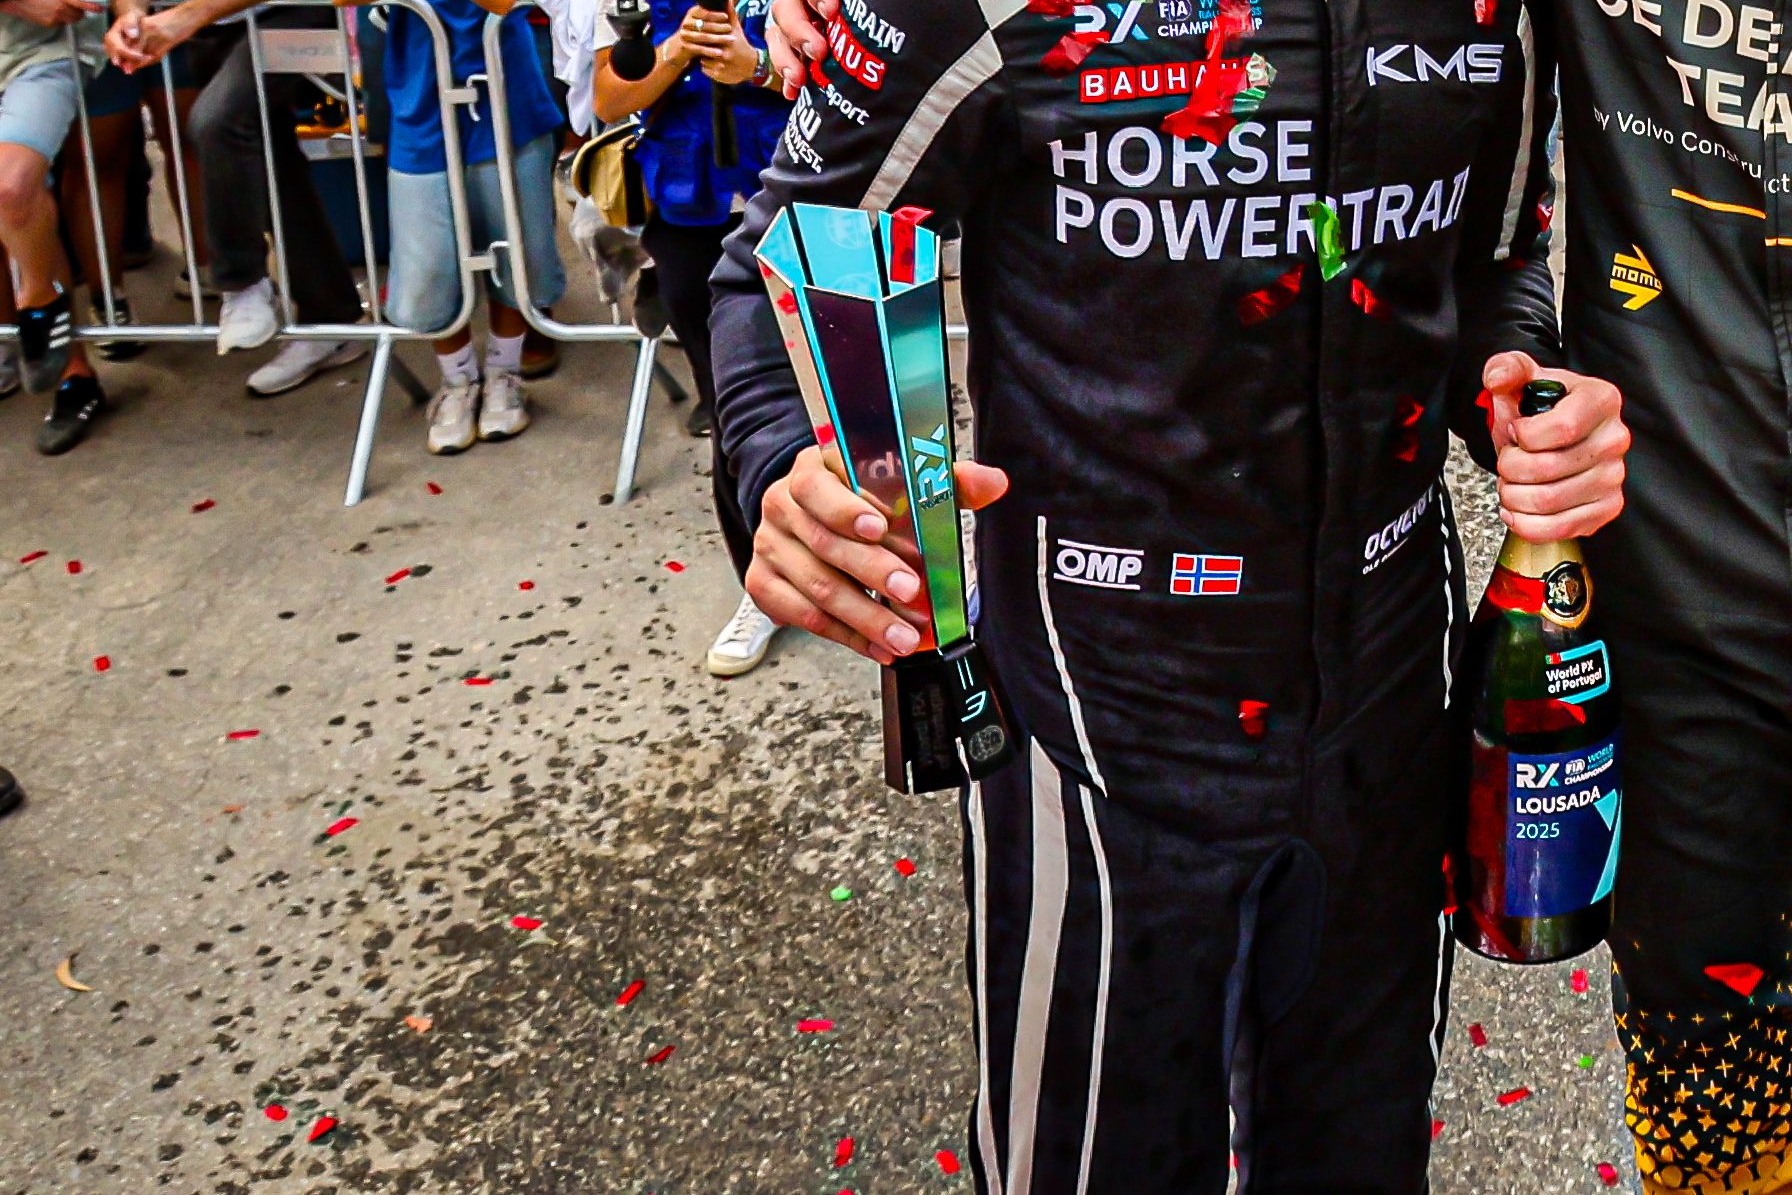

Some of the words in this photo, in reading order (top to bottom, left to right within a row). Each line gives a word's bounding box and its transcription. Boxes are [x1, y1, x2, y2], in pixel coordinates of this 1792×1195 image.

[1158, 0, 1190, 19] FIA
[1365, 44, 1505, 87] KMS
[1616, 110, 1674, 146] Volvo
[1047, 119, 1313, 188] HORSE
[1055, 547, 1143, 585] OMP
[1546, 662, 1580, 682] World
[1547, 682, 1561, 694] of
[1562, 668, 1603, 691] Portugal
[961, 690, 987, 723] 3
[1515, 762, 1560, 789] RX
[1516, 785, 1601, 815] LOUSADA
[1516, 822, 1561, 839] 2025
